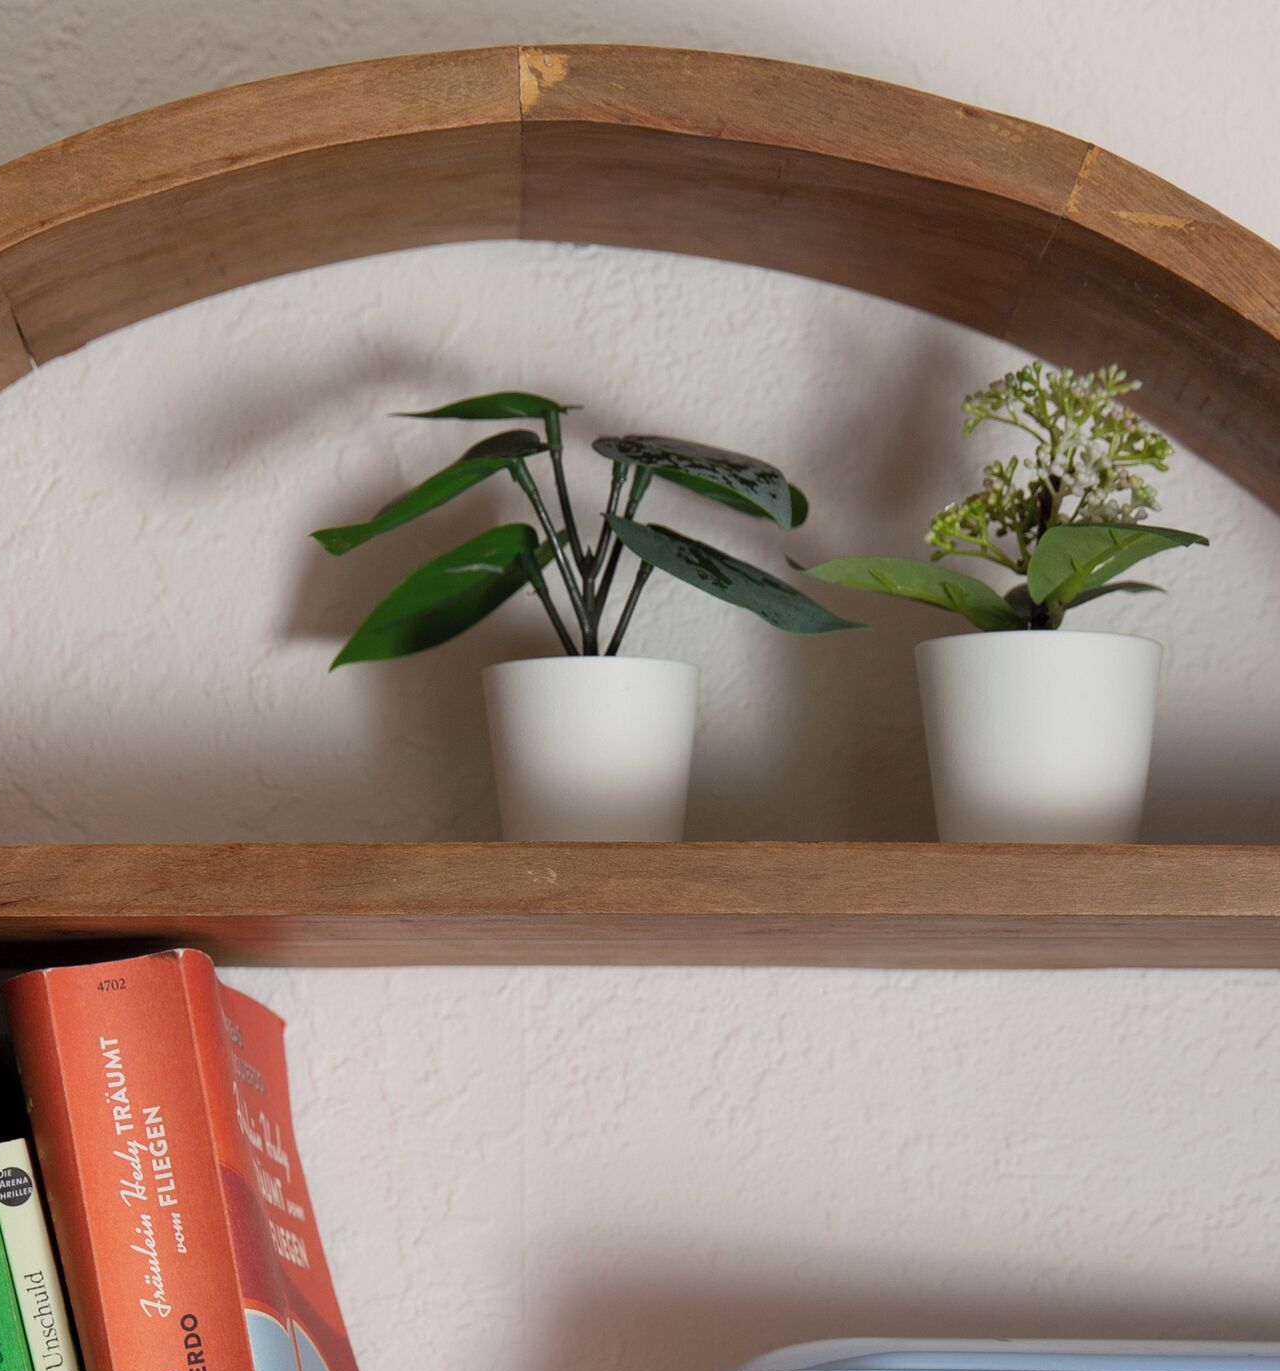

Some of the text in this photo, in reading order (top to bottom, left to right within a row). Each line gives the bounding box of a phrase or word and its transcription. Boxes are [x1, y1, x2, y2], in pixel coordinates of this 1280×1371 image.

[97, 978, 127, 993] 4702
[0, 1177, 29, 1189] ARENA
[99, 1036, 172, 1319] Fräulein Hedy TRÄUMT
[143, 1105, 188, 1255] vom FLIEGEN
[23, 1269, 64, 1371] Unschuld
